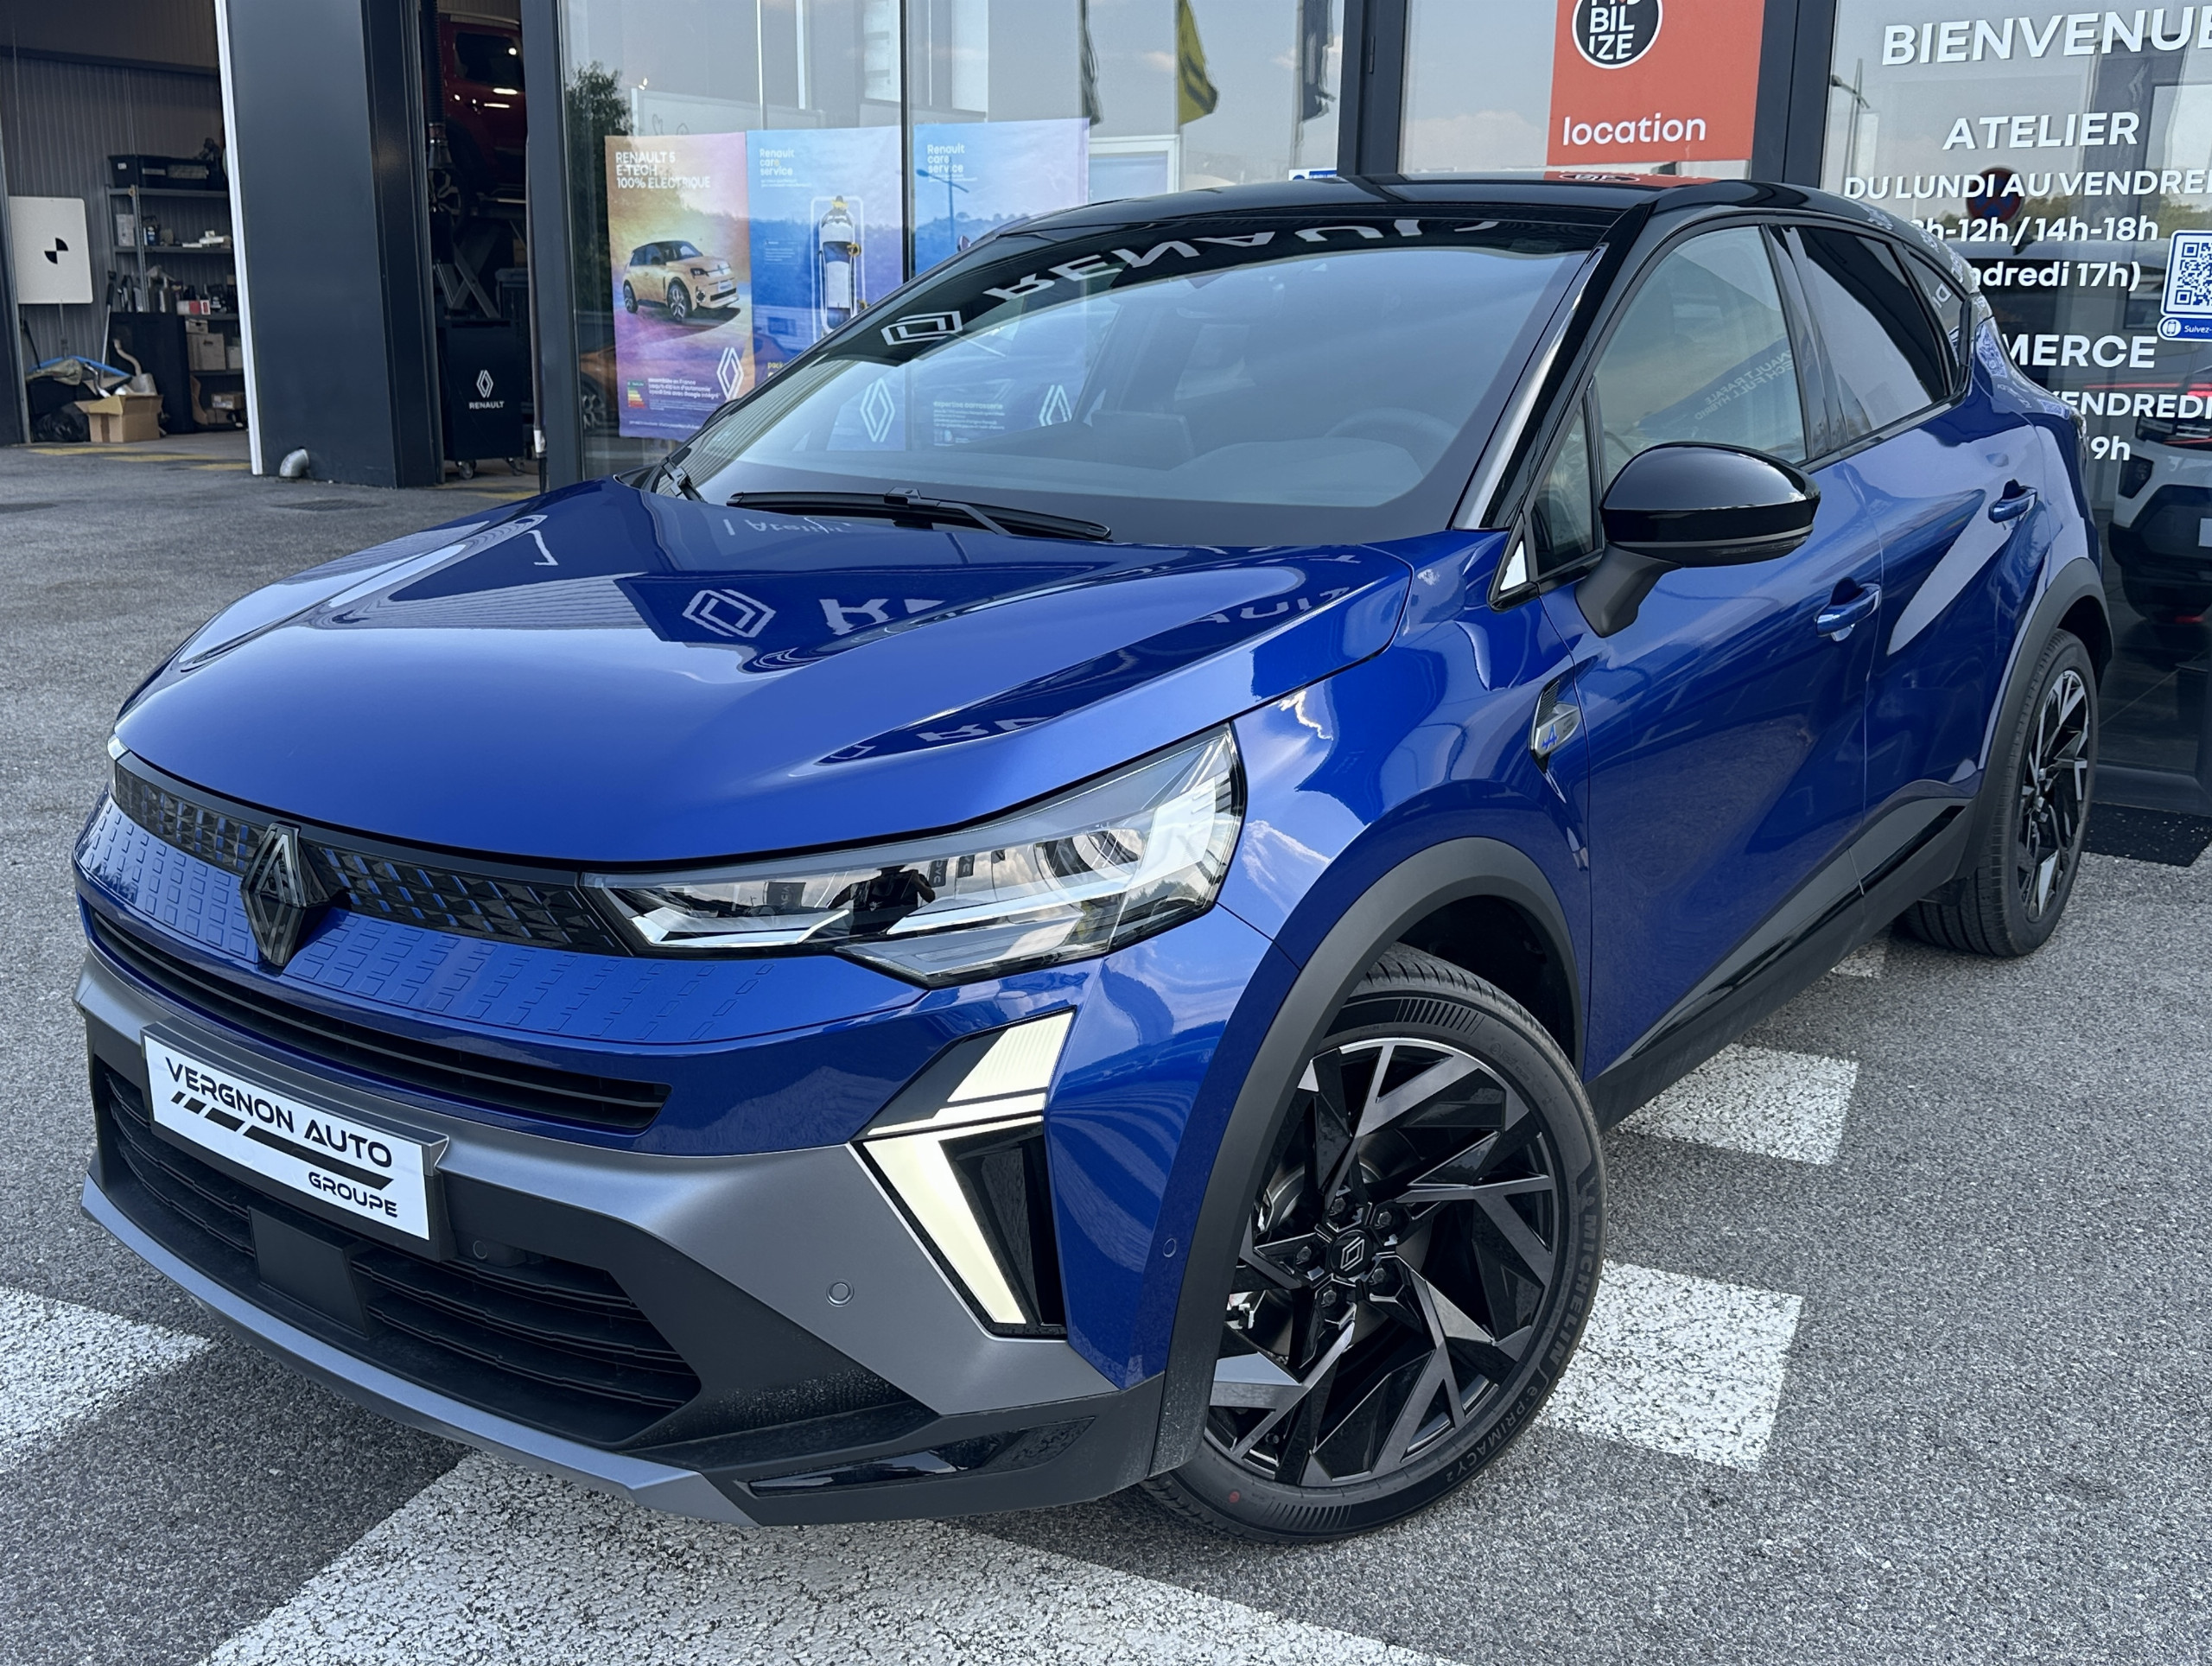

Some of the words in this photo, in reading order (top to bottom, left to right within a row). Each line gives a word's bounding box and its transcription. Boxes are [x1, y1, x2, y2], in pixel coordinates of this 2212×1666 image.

[1590, 5, 1635, 33] BIL
[1588, 33, 1634, 60] IZE
[1562, 112, 1706, 146] location
[1942, 111, 2140, 150] ATELIER
[615, 151, 667, 164] RENAULT
[669, 151, 676, 163] 5
[760, 148, 795, 158] Renault
[926, 143, 965, 155] Renault
[927, 155, 950, 164] care
[616, 164, 658, 176] E-TECH
[616, 177, 646, 188] 100%
[927, 164, 963, 174] servce
[1844, 176, 1889, 200] DU
[1895, 174, 1995, 199] LUNDI
[2003, 173, 2051, 198] AU
[2057, 169, 2212, 196] VENDRE
[1911, 216, 2009, 242] h-12h
[2035, 215, 2158, 242] 14h-18h
[2076, 261, 2141, 292] 17h)
[469, 401, 505, 410] RENAULT
[2053, 391, 2212, 420] ENDREDI
[2087, 435, 2131, 461] 9h
[165, 1056, 295, 1134] VERGNON
[304, 1119, 392, 1168] AUTO
[308, 1171, 398, 1218] GROUPE
[1551, 1214, 1598, 1367] MICHELIN
